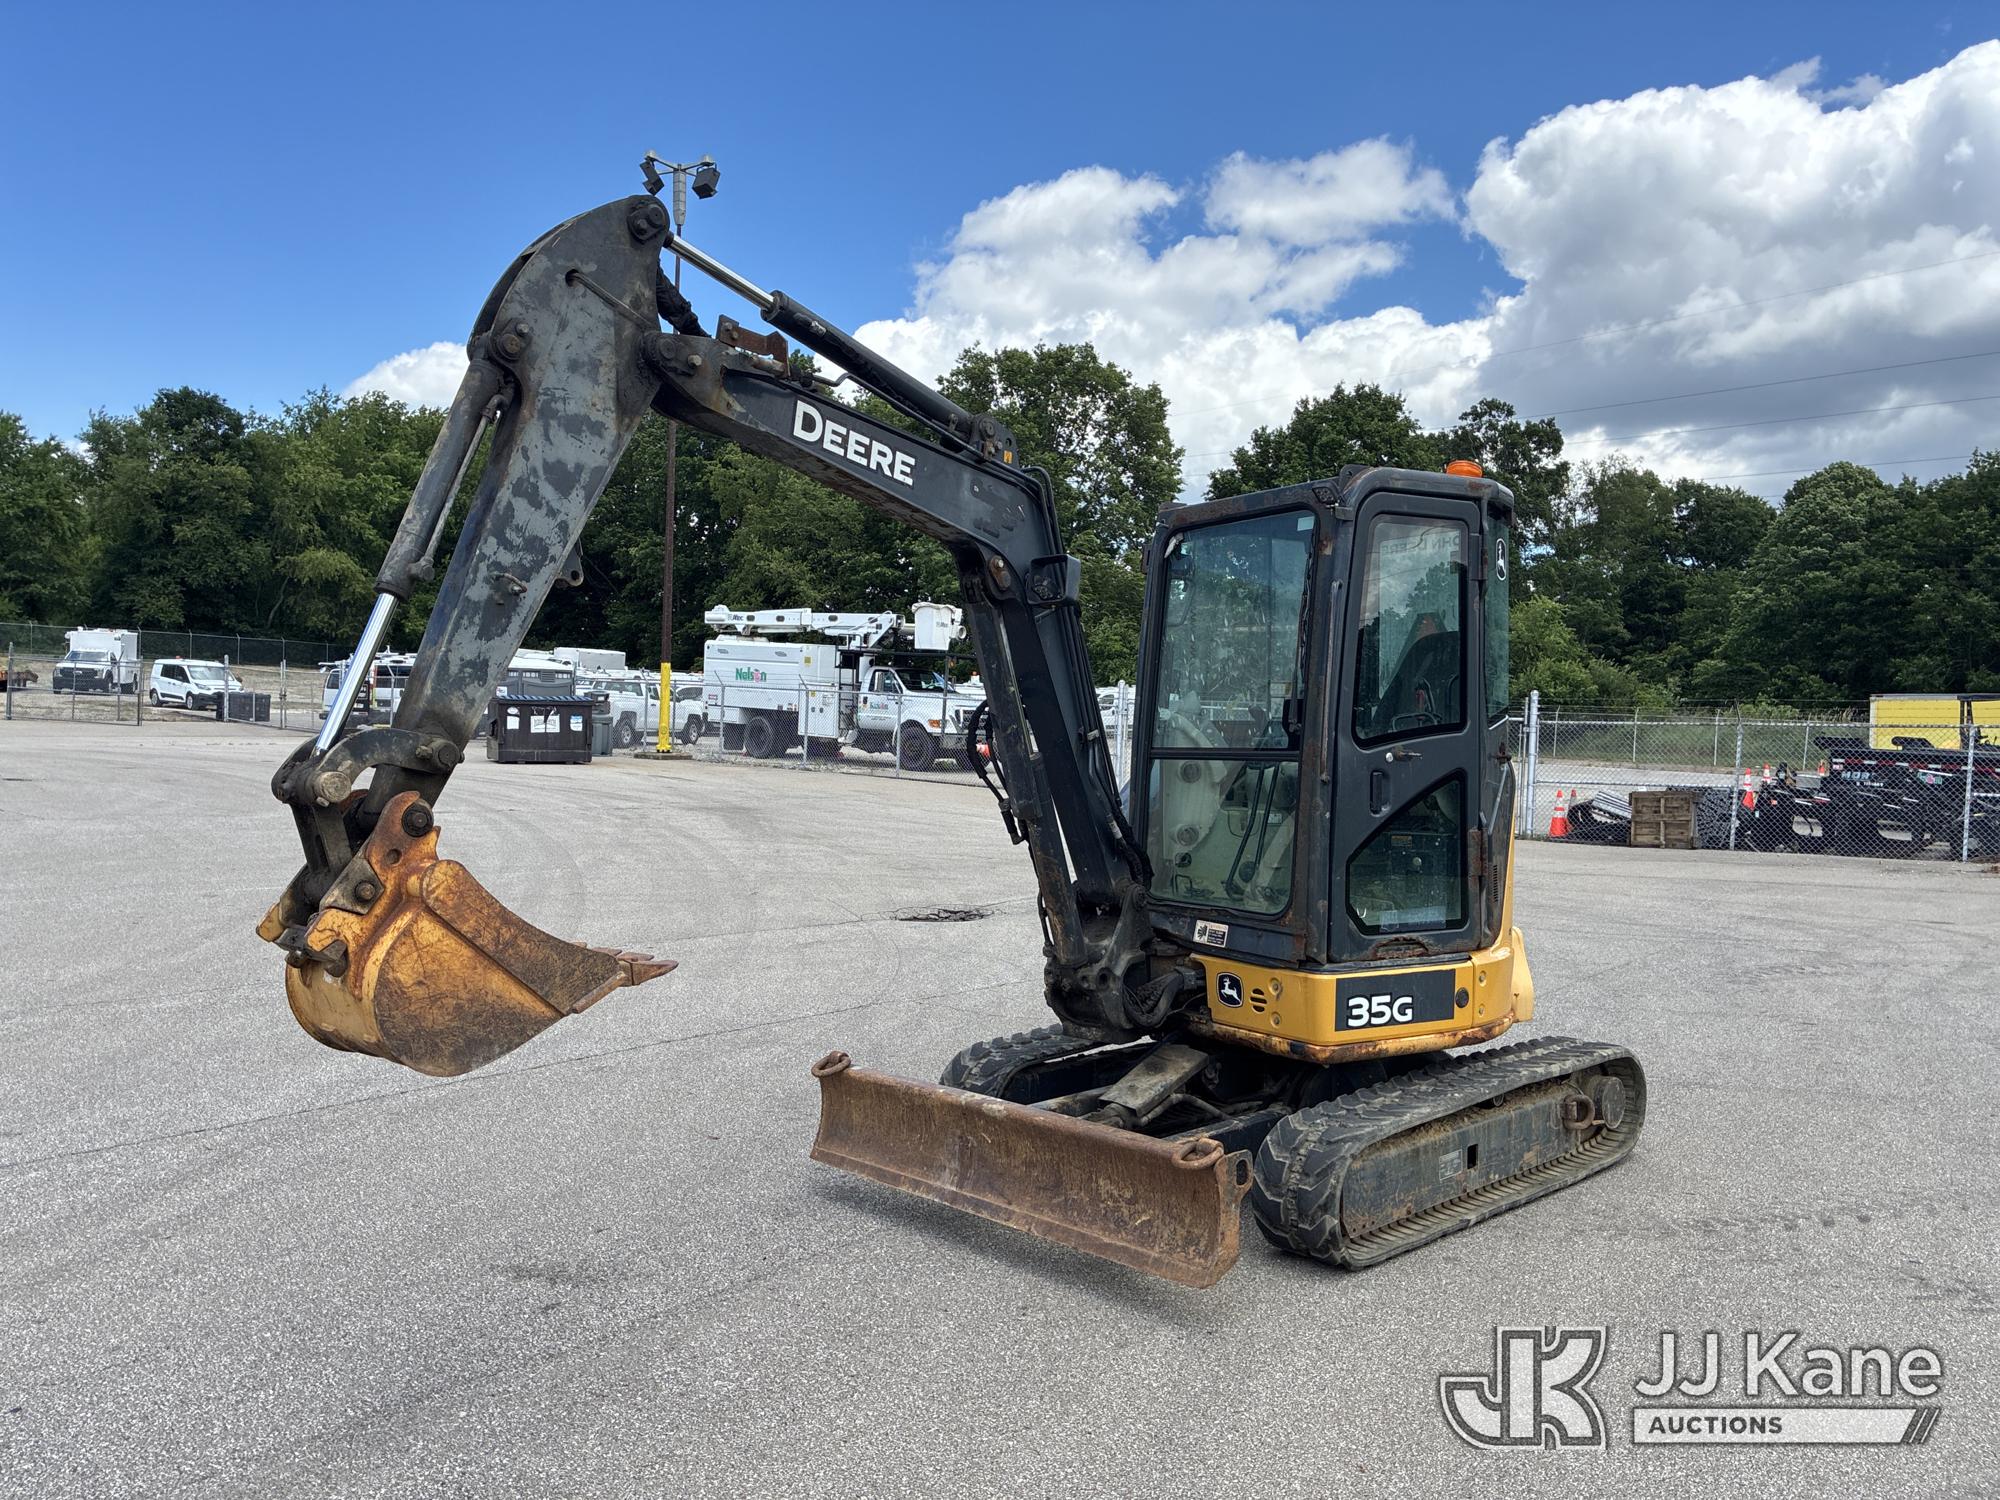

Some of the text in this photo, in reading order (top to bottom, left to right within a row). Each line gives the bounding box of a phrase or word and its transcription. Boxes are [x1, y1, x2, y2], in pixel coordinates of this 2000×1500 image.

[793, 400, 916, 486] DEERE
[736, 667, 767, 683] Nelson
[1347, 994, 1413, 1028] 35G
